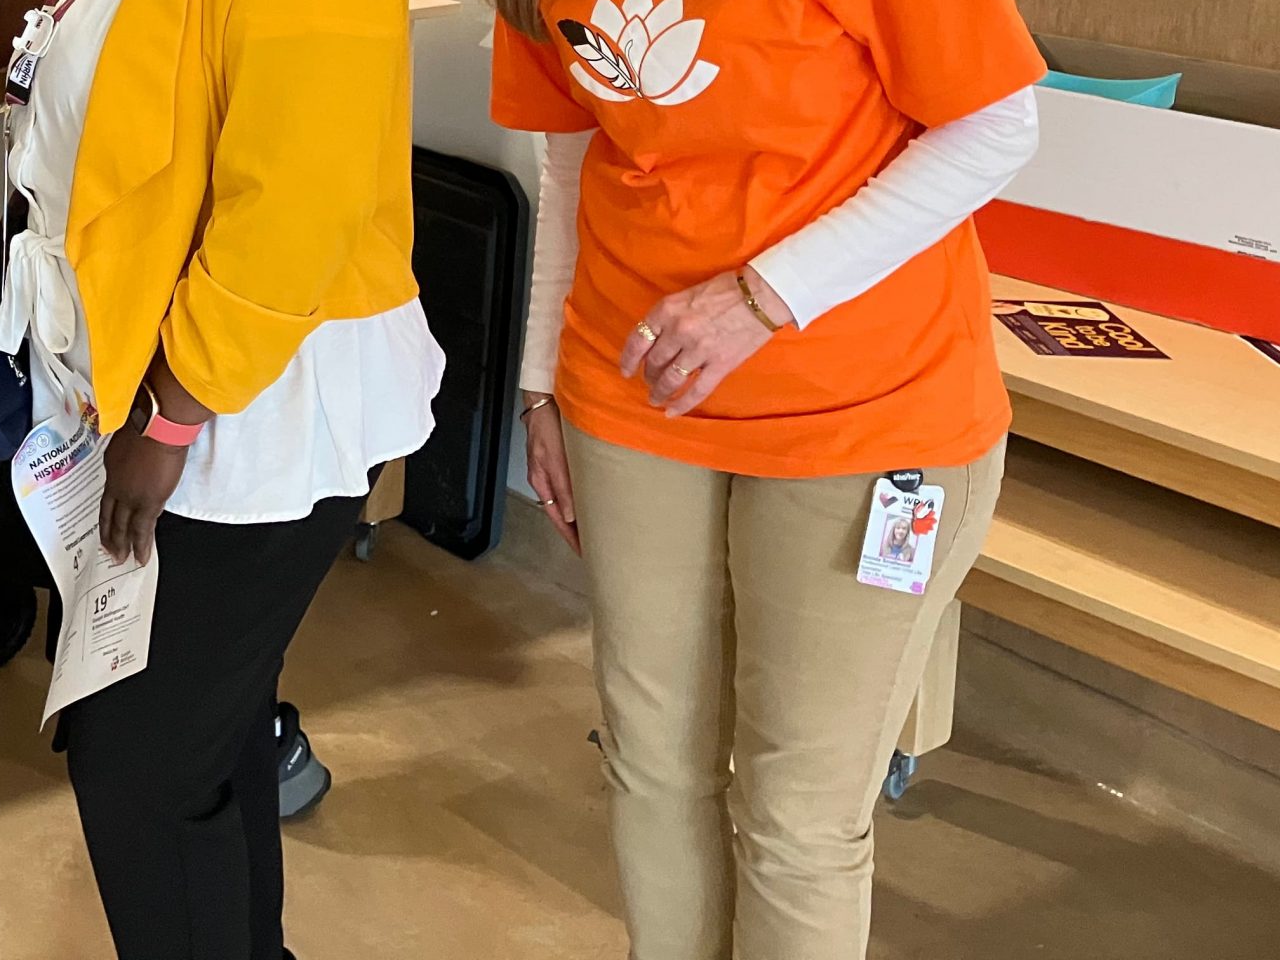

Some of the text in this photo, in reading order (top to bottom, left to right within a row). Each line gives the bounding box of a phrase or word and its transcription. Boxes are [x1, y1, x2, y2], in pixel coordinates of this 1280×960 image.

[29, 440, 70, 470] NATIONAL
[33, 455, 69, 481] HISTORY
[93, 587, 116, 614] 19th
